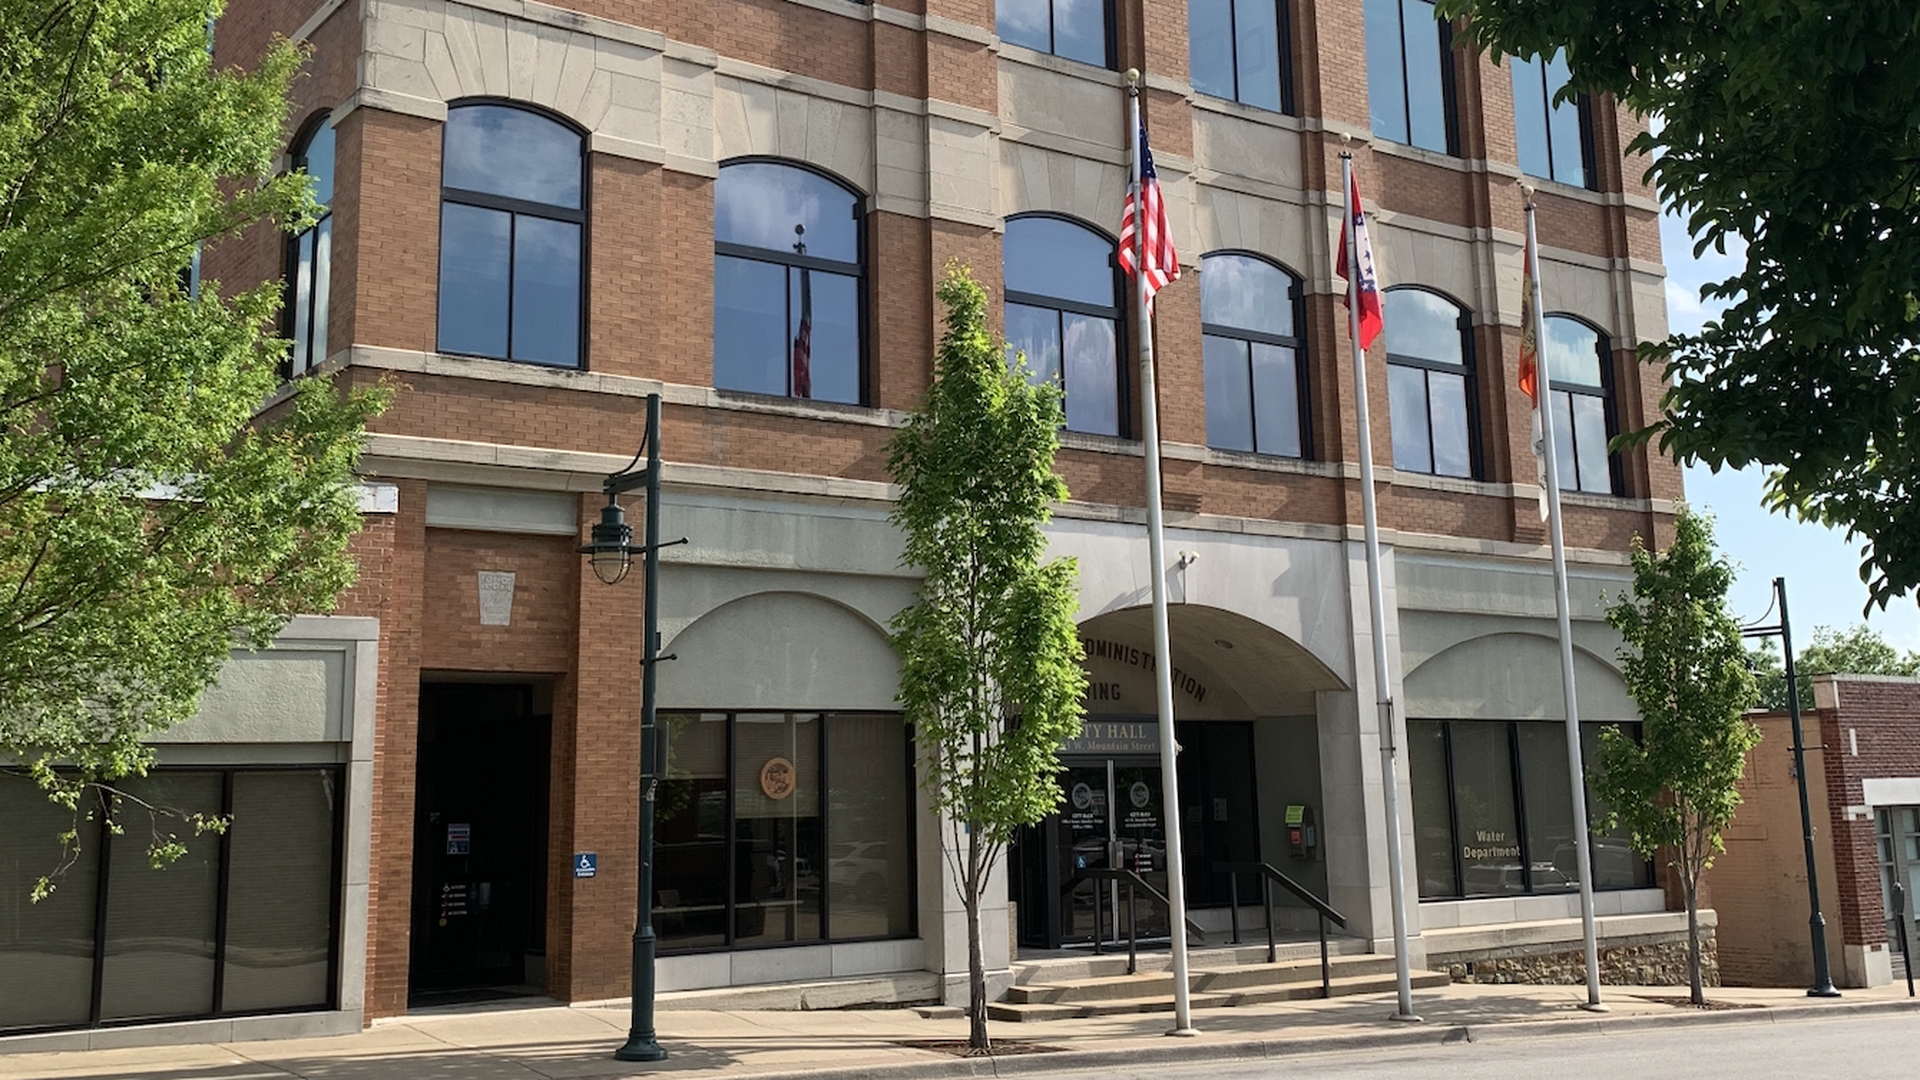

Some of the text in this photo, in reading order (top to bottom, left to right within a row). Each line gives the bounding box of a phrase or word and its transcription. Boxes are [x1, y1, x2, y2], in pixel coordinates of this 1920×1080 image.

[1107, 724, 1147, 739] HALL
[1087, 741, 1128, 751] Mountain
[1130, 741, 1156, 751] Street
[1476, 830, 1505, 842] Water
[1463, 845, 1521, 860] Department
